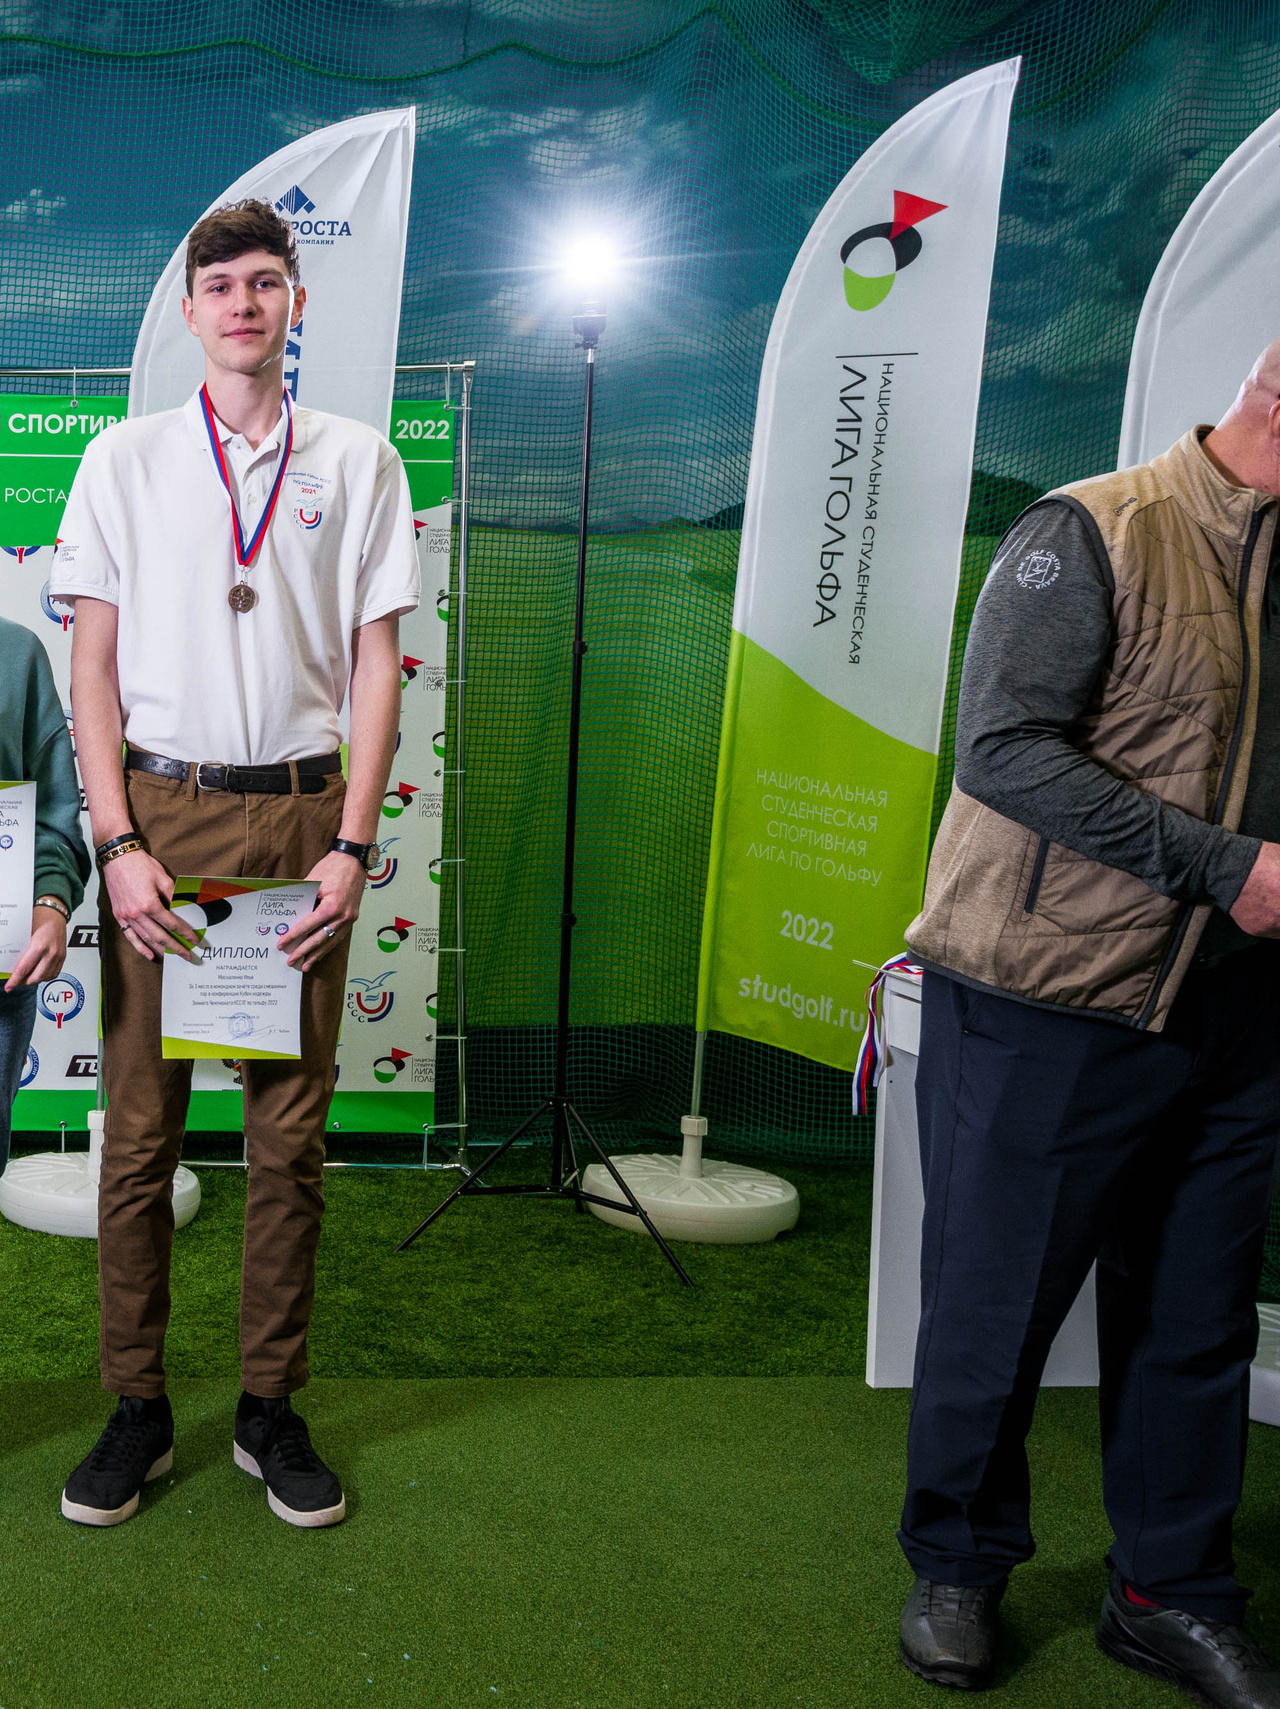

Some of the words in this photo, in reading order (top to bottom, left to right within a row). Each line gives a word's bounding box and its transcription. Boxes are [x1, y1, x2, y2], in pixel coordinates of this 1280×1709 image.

[395, 420, 450, 440] 2022
[834, 364, 867, 469] ЛИГА
[864, 362, 895, 522] НАЦИОНАЛЬНАЯ
[4, 488, 71, 503] РОСТА
[429, 546, 450, 554] ГОЛЬ
[813, 476, 856, 628] ГОЛЬФА
[848, 526, 874, 666] СТУДЕНЧЕСКАЯ
[755, 768, 888, 808] НАЦИОНАЛЬНАЯ
[421, 810, 443, 818] ГОЛЬ
[761, 794, 878, 833] СТУДЕНЧЕСКАЯ
[767, 820, 868, 857] СПОРТИВНАЯ
[745, 841, 787, 865] ЛИГА
[789, 850, 812, 871] ПО
[814, 855, 883, 888] ГОЛЬФУ
[779, 909, 834, 951] 2022
[201, 947, 269, 960] ДИПЛОМ
[738, 973, 866, 1033] studgolf.ru
